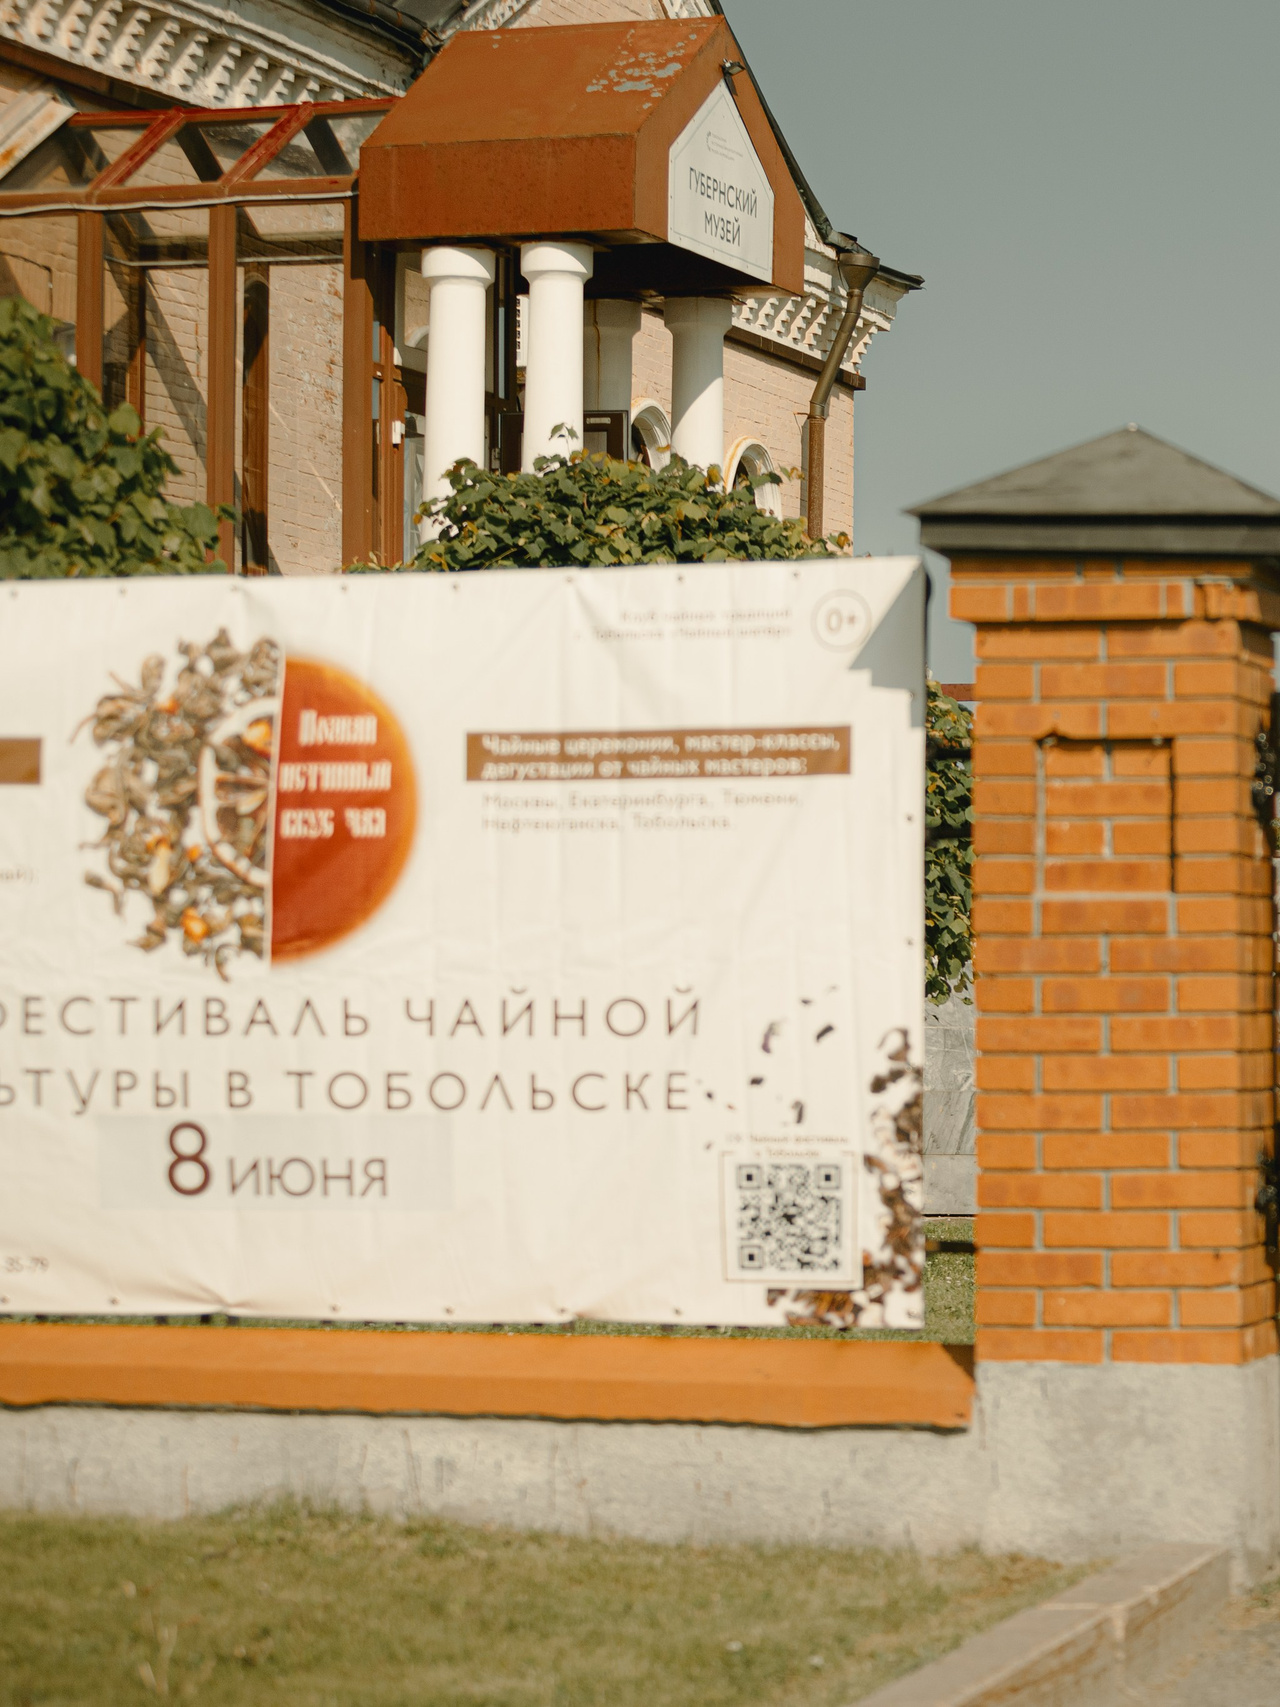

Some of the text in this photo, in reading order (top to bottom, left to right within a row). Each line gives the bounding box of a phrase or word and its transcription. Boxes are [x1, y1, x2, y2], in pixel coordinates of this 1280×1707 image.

[689, 166, 758, 218] ГУБЕРНСКИЙ
[704, 211, 741, 247] МУЗЕЙ
[824, 606, 858, 634] 0+
[482, 734, 561, 756] Чайные
[599, 760, 623, 777] от
[626, 756, 700, 777] чайных
[0, 987, 700, 1037] ЕСТИВАЛЬ ЧАЙНОЙ
[227, 1070, 254, 1108] В
[285, 1070, 689, 1111] ТОБОЛЬСКЕ
[167, 1121, 388, 1198] 8 ИЮНЯ
